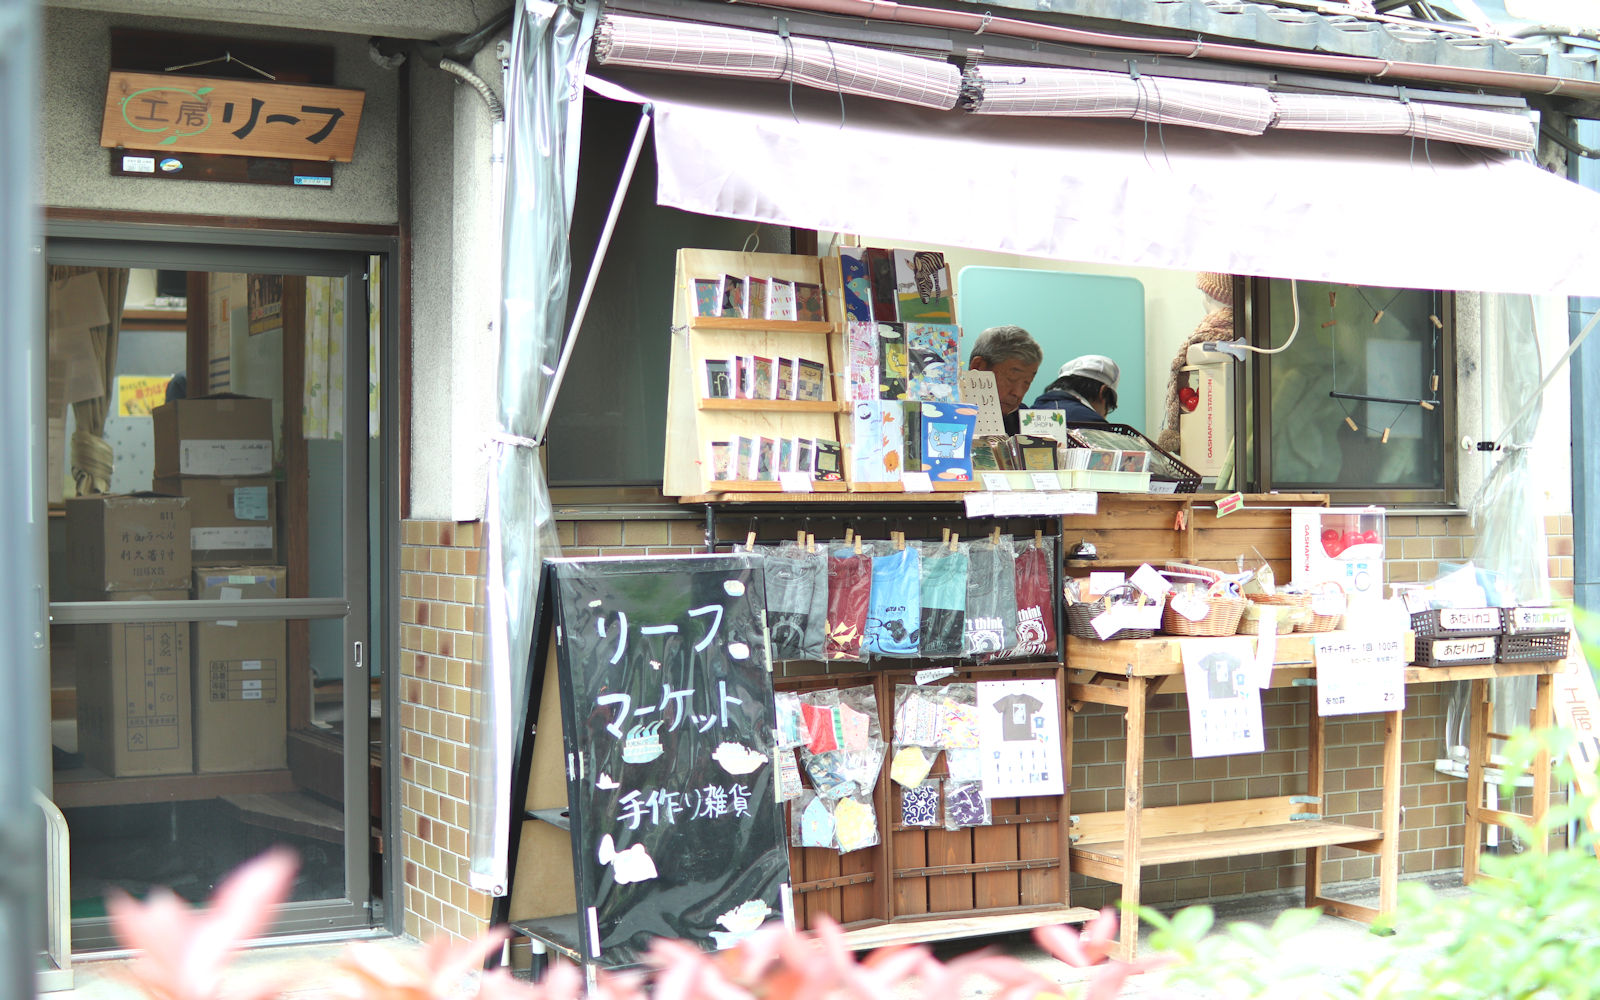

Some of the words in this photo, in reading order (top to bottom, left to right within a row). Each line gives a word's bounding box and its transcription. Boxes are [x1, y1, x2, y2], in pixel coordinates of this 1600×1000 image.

[135, 97, 209, 127] 工房
[222, 97, 345, 144] リーフ
[975, 616, 1003, 630] think
[1017, 604, 1042, 621] think
[1449, 613, 1491, 624] あたりカゴ
[597, 604, 724, 665] リーフ
[1443, 642, 1486, 655] あたりカゴ
[596, 680, 743, 740] マーケット
[616, 783, 753, 831] 手作り雑貨
